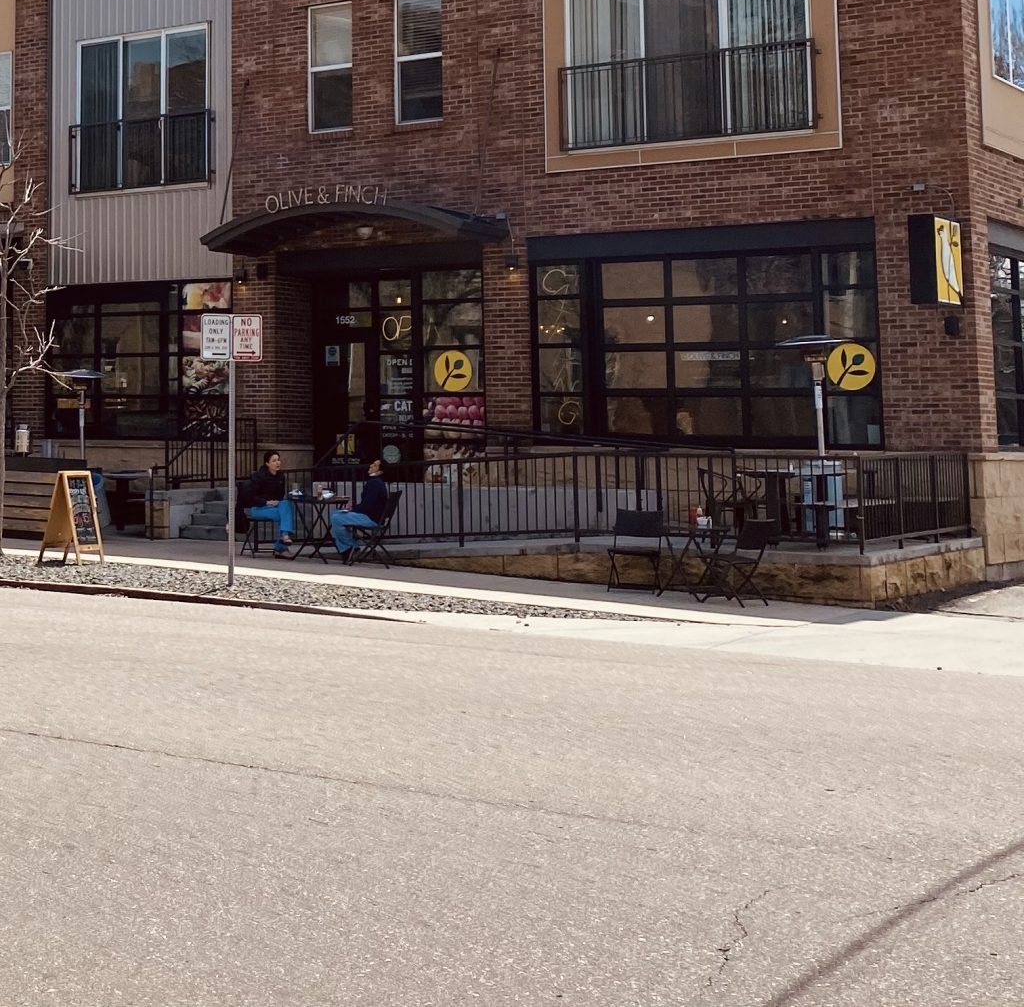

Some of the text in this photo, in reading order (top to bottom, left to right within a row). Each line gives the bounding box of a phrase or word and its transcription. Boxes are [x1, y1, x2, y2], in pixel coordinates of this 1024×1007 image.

[265, 184, 387, 213] OLIVE & FINCH
[240, 317, 252, 327] NO
[335, 315, 356, 325] 1552
[234, 328, 260, 337] PARKING
